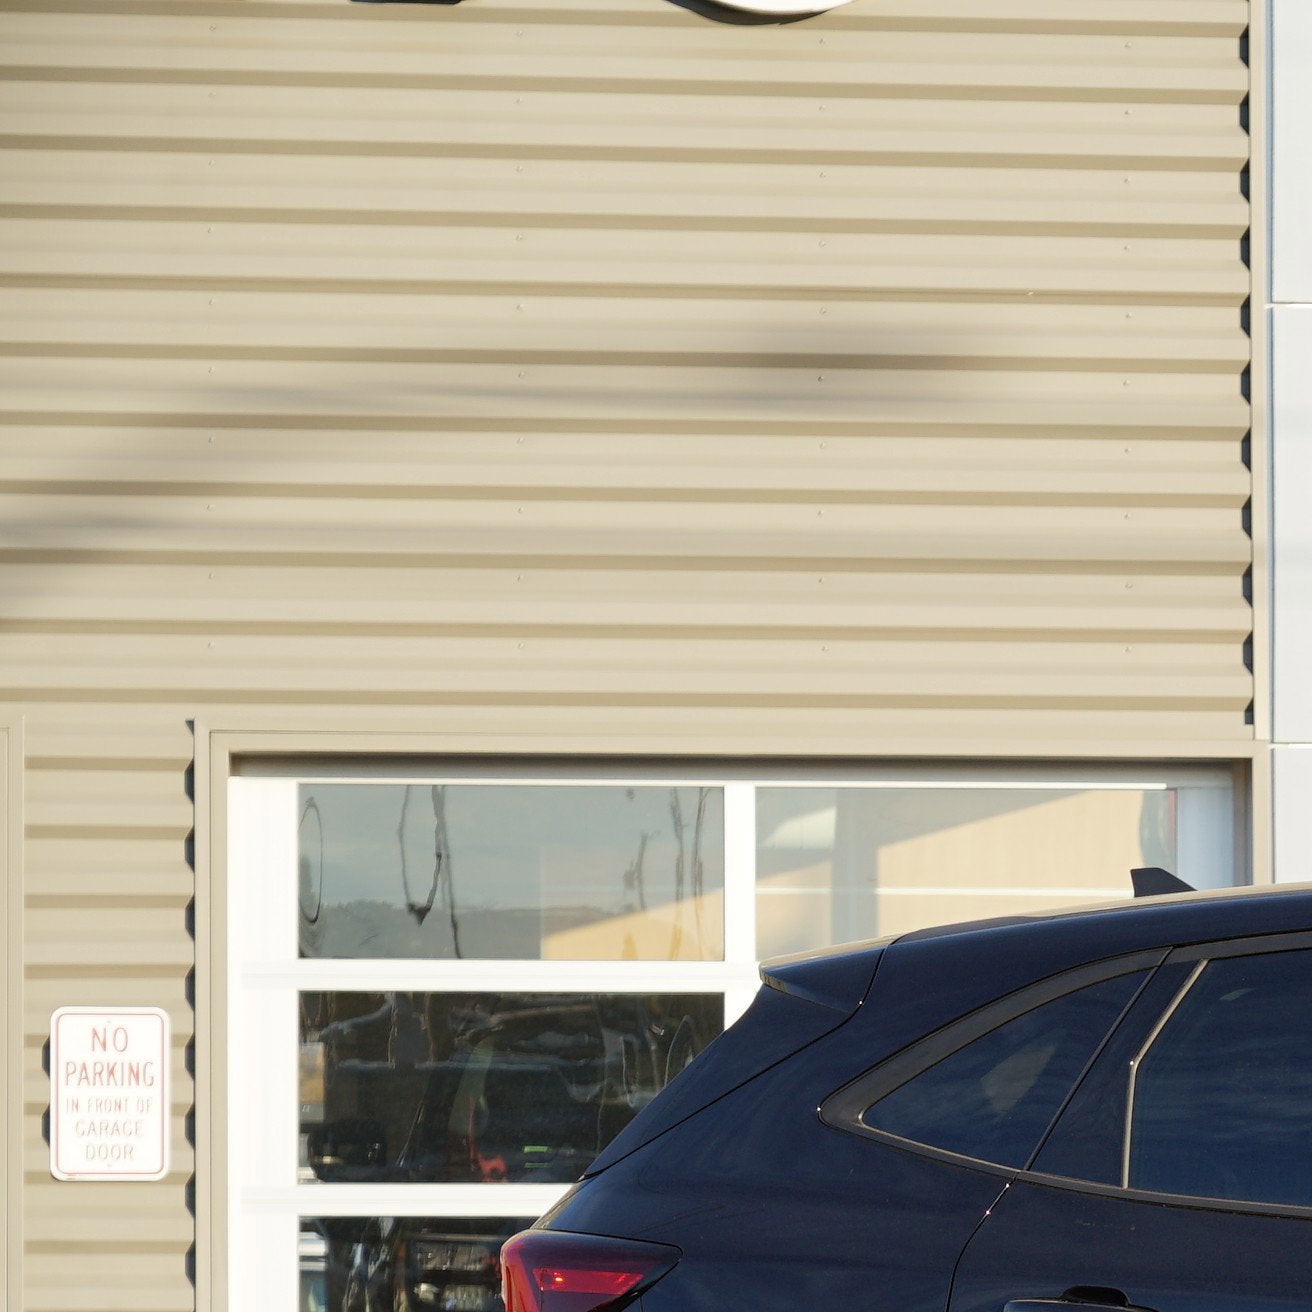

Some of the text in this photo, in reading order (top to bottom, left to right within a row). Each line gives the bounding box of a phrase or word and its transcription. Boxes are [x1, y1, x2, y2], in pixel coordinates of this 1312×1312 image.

[91, 1027, 129, 1053] NO
[65, 1061, 155, 1087] PARKING
[66, 1097, 152, 1113] IN FRONT OF
[75, 1119, 143, 1137] GARAGE
[85, 1143, 134, 1160] DOOR
